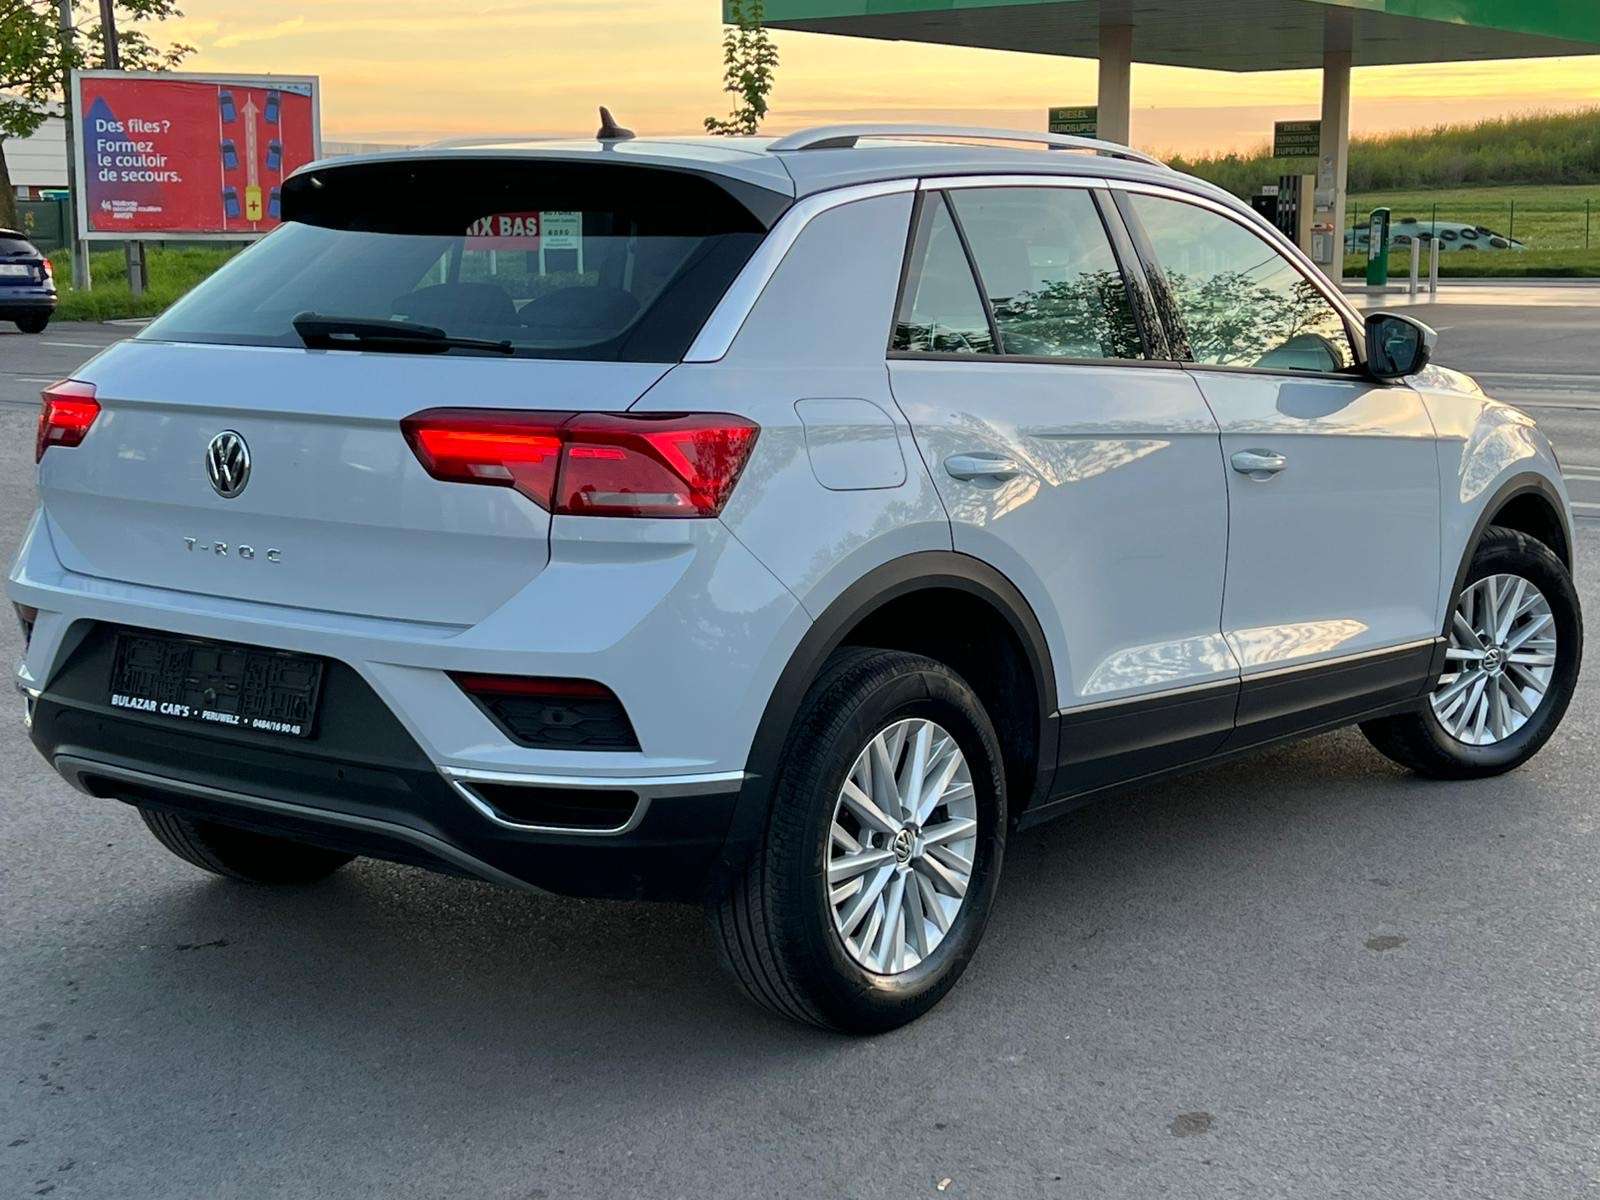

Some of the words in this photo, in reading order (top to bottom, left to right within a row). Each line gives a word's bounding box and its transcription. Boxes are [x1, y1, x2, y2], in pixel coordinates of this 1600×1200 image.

[1058, 110, 1089, 120] DIESEL
[95, 119, 124, 133] Des
[97, 139, 154, 153] Formez
[98, 154, 113, 168] le
[116, 153, 167, 168] couloir
[98, 169, 118, 183] de
[121, 170, 182, 183] secours.
[499, 216, 538, 237] BAS
[183, 535, 282, 563] T-ROC
[111, 694, 157, 713] BULAZAR
[160, 702, 190, 717] CAR'S
[201, 710, 240, 725] PERUWELZ
